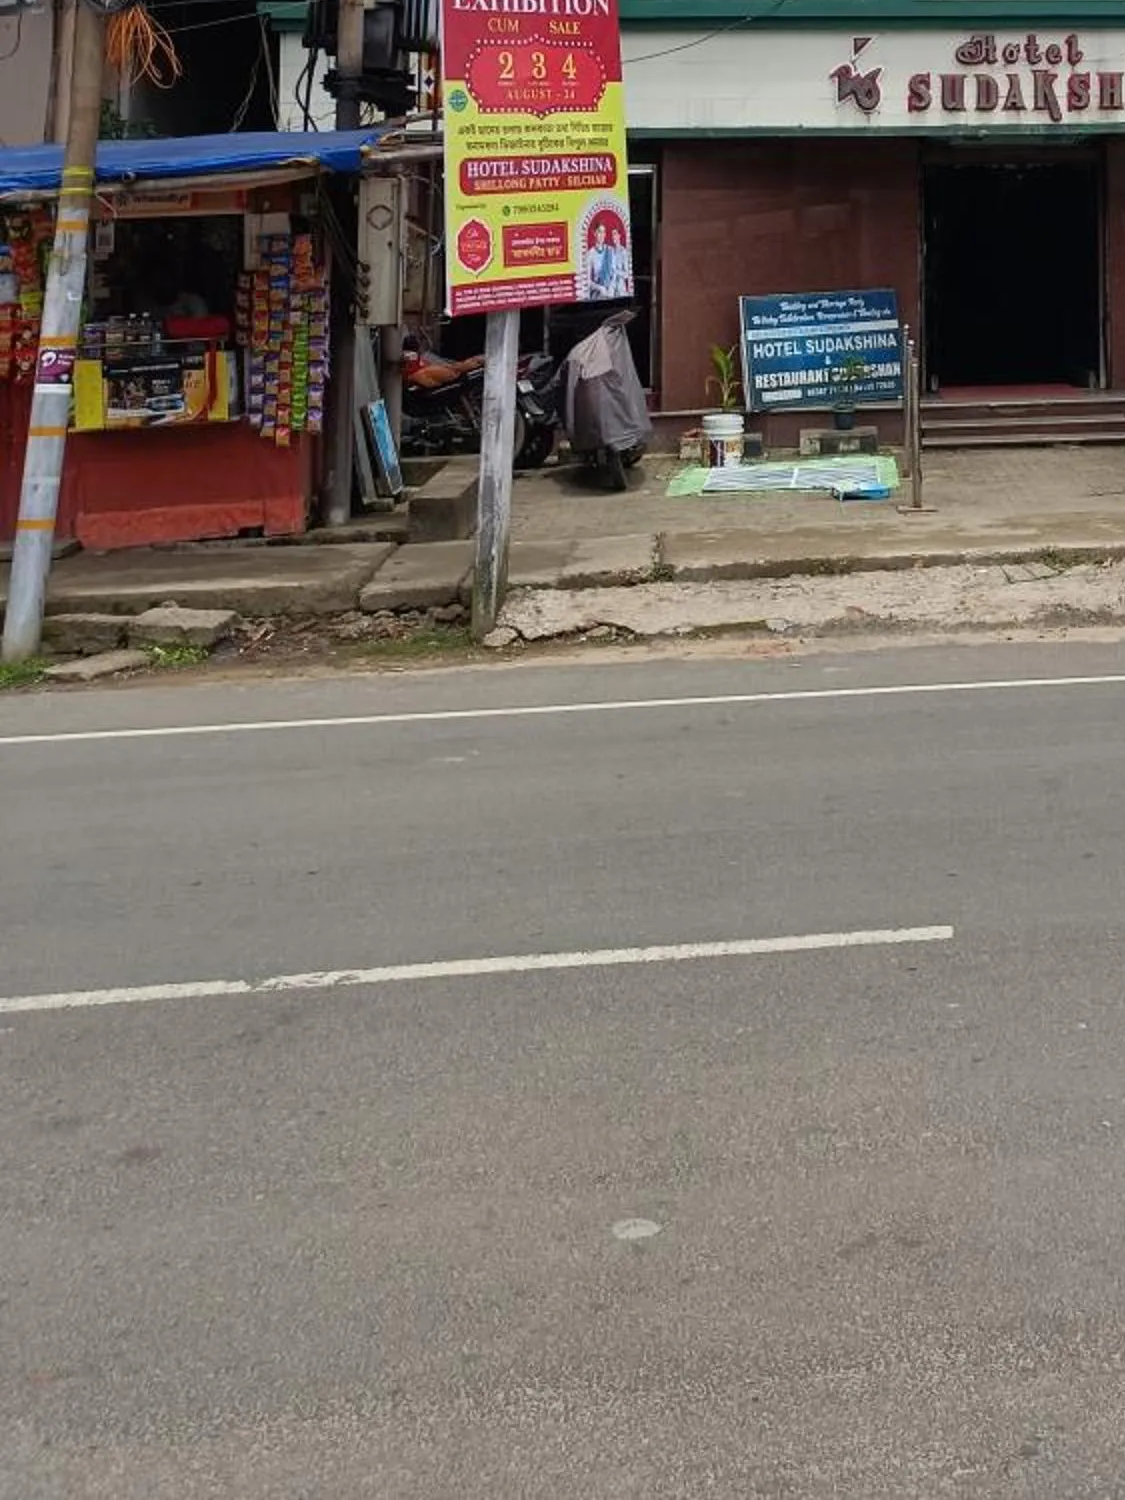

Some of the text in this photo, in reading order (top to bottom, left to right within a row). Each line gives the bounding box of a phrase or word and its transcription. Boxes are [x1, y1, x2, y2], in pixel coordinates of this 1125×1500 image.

[487, 17, 581, 35] CUM SALE
[956, 34, 1084, 66] Hotel
[499, 51, 577, 80] 2 3 4
[505, 89, 552, 101] AUGUST
[467, 157, 613, 177] HOTEL SUDAKSHINA
[753, 333, 897, 359] HOTEL SUDAKSHINA
[755, 368, 830, 389] RESTAURANT
